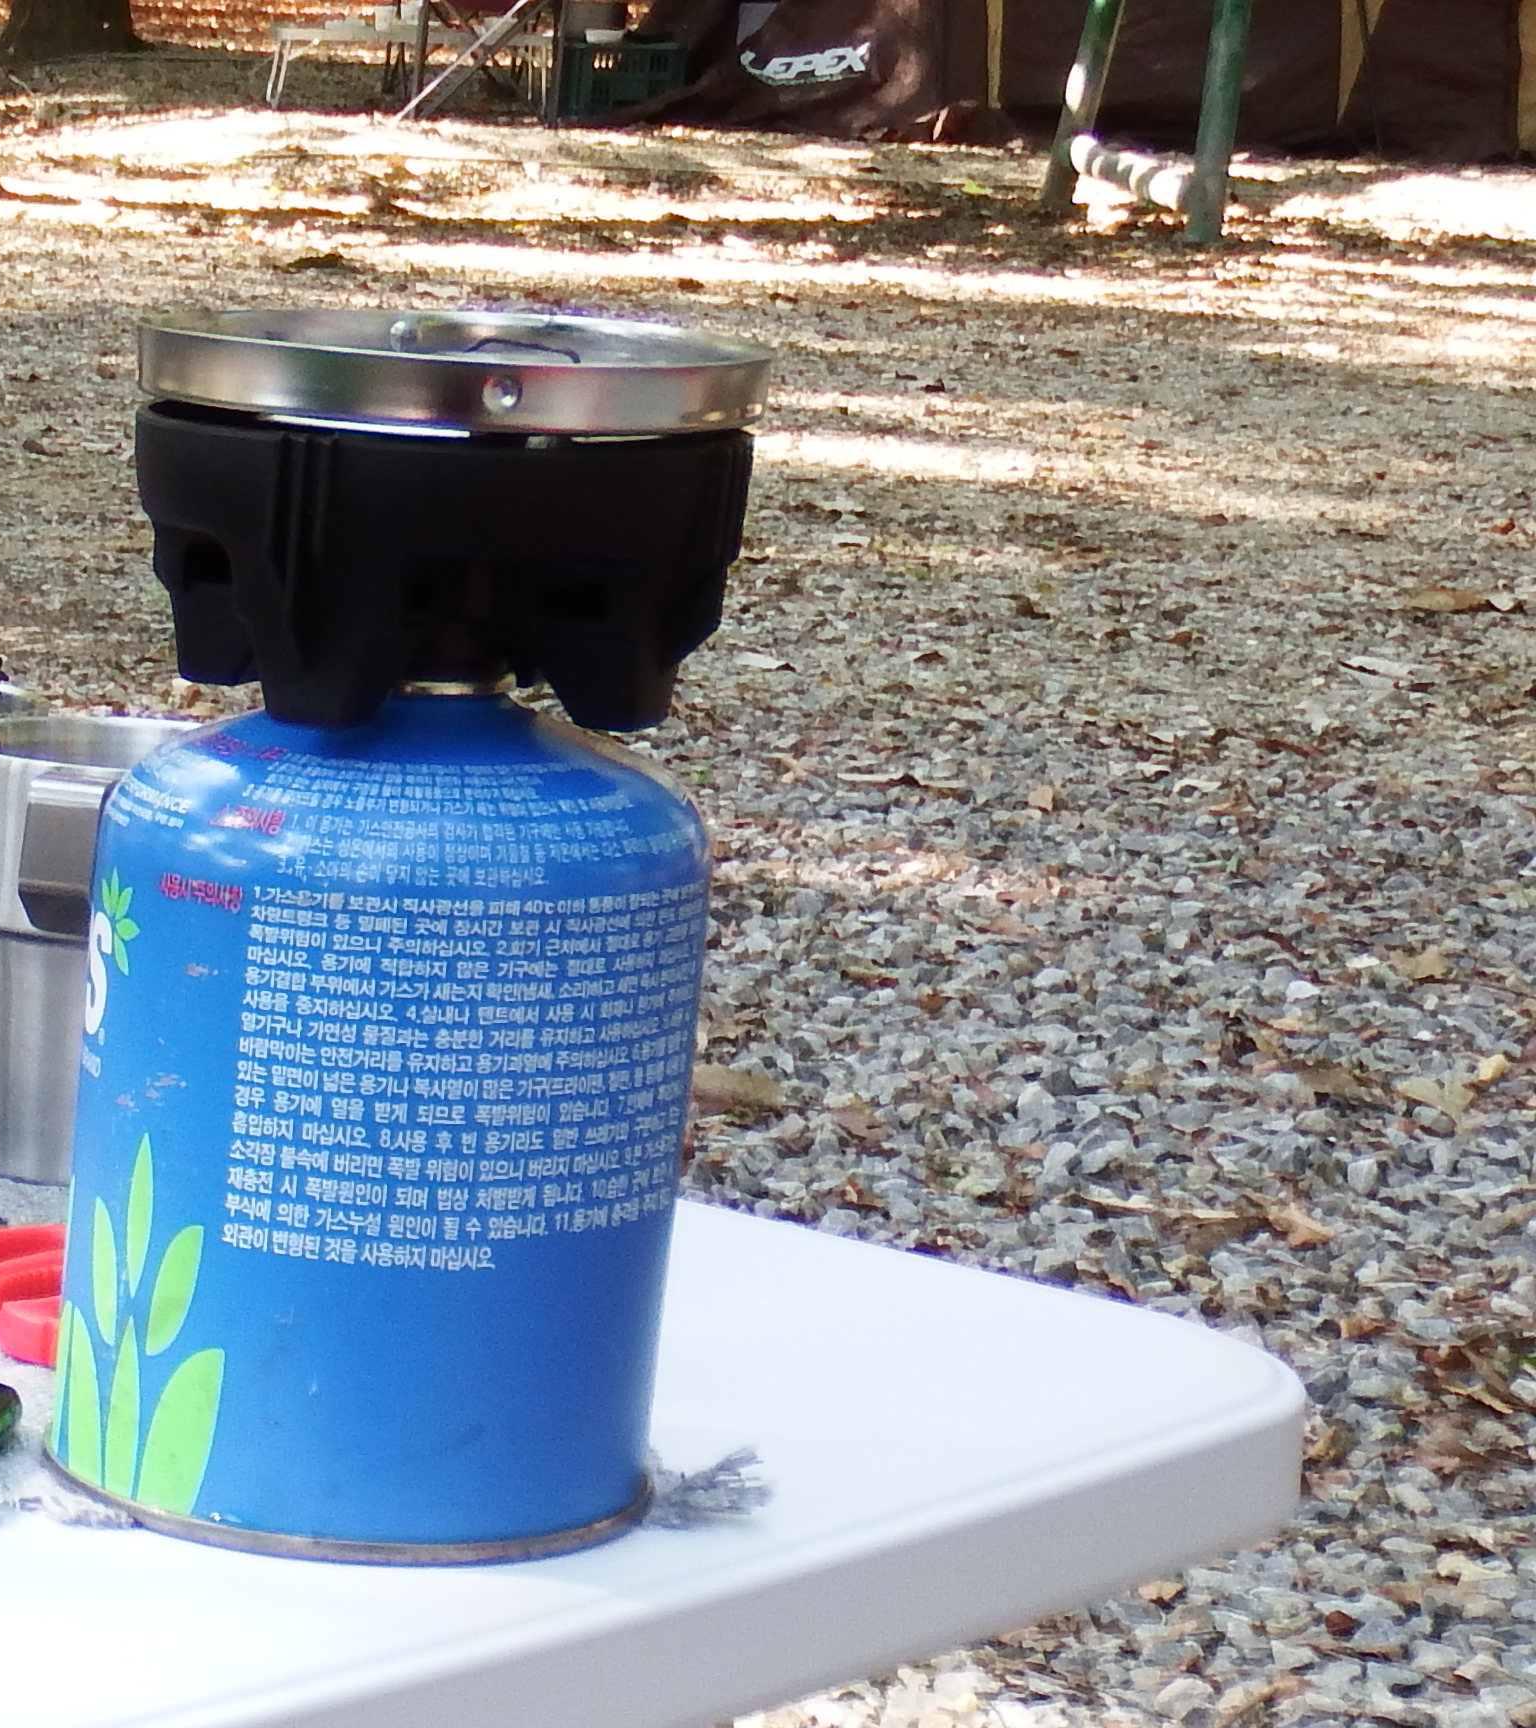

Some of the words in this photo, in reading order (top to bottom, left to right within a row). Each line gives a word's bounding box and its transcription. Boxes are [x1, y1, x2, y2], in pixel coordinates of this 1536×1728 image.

[346, 894, 397, 913] 보관시
[402, 897, 484, 916] 직사광선을
[488, 899, 521, 916] 피해
[248, 923, 326, 949] 폭발위험이
[332, 932, 381, 953] 있으니
[545, 935, 601, 955] 근처에서
[333, 913, 351, 930] 등
[414, 918, 447, 935] 곳에
[453, 919, 503, 936] 장시간
[508, 919, 540, 936] 보관
[545, 918, 560, 935] 시
[244, 966, 306, 991] 용기결합
[310, 973, 376, 997] 부위에서
[378, 979, 429, 1000] 가스가
[432, 981, 482, 1001] 새는지
[321, 953, 371, 974] 용기에
[380, 957, 447, 978] 적합하지
[456, 960, 489, 978] 않은
[496, 959, 559, 978] 기구에는
[241, 988, 289, 1012] 사용을
[405, 1003, 470, 1024] 4.실내나
[477, 1004, 540, 1024] 텐트에서
[545, 1002, 575, 1023] 사용
[580, 1001, 594, 1021] 시
[240, 1011, 302, 1038] 열기구나
[307, 1019, 356, 1043] 가연성
[362, 1023, 429, 1047] 물질과는
[434, 1027, 484, 1048] 충분한
[488, 1027, 535, 1048] 거리를
[539, 1024, 595, 1047] 유지하고
[238, 1035, 316, 1065] 바람막이는
[319, 1045, 403, 1071] 안전거리를
[406, 1051, 473, 1073] 유지하고
[475, 1051, 553, 1073] 용기과열에
[236, 1059, 268, 1084] 있는
[322, 1070, 356, 1093] 넓은
[358, 1073, 409, 1097] 용기나
[413, 1077, 478, 1099] 복사열이
[482, 1077, 514, 1099] 많은
[234, 1084, 266, 1110] 경우
[272, 1089, 322, 1117] 용기에
[330, 1096, 365, 1121] 열을
[373, 1100, 407, 1124] 받게
[416, 1102, 467, 1125] 되므로
[473, 1101, 551, 1125] 폭발위험이
[232, 1110, 293, 1141] 흡입하지
[435, 1129, 452, 1152] 후
[461, 1130, 477, 1152] 빈
[483, 1128, 545, 1152] 용기라도
[229, 1139, 275, 1166] 소각장
[279, 1146, 328, 1173] 불속에
[333, 1152, 383, 1179] 버리면
[387, 1156, 420, 1181] 폭발
[425, 1158, 473, 1182] 위험이
[478, 1157, 524, 1181] 있으니
[528, 1154, 569, 1179] 버리지
[227, 1165, 273, 1196] 재충전
[280, 1174, 297, 1199] 시
[304, 1177, 387, 1208] 폭발원인이
[394, 1185, 428, 1210] 되며
[436, 1187, 469, 1210] 법상
[475, 1184, 536, 1210] 처벌받게
[224, 1192, 271, 1223] 부식에
[276, 1201, 310, 1229] 의한
[314, 1206, 382, 1237] 가스누설
[387, 1213, 437, 1239] 원인이
[442, 1215, 459, 1239] 될
[465, 1215, 482, 1239] 수
[487, 1211, 550, 1239] 있습니다.
[221, 1222, 268, 1253] 외관이
[271, 1230, 320, 1261] 변형된
[323, 1237, 357, 1265] 것을
[360, 1240, 426, 1269] 사용하지
